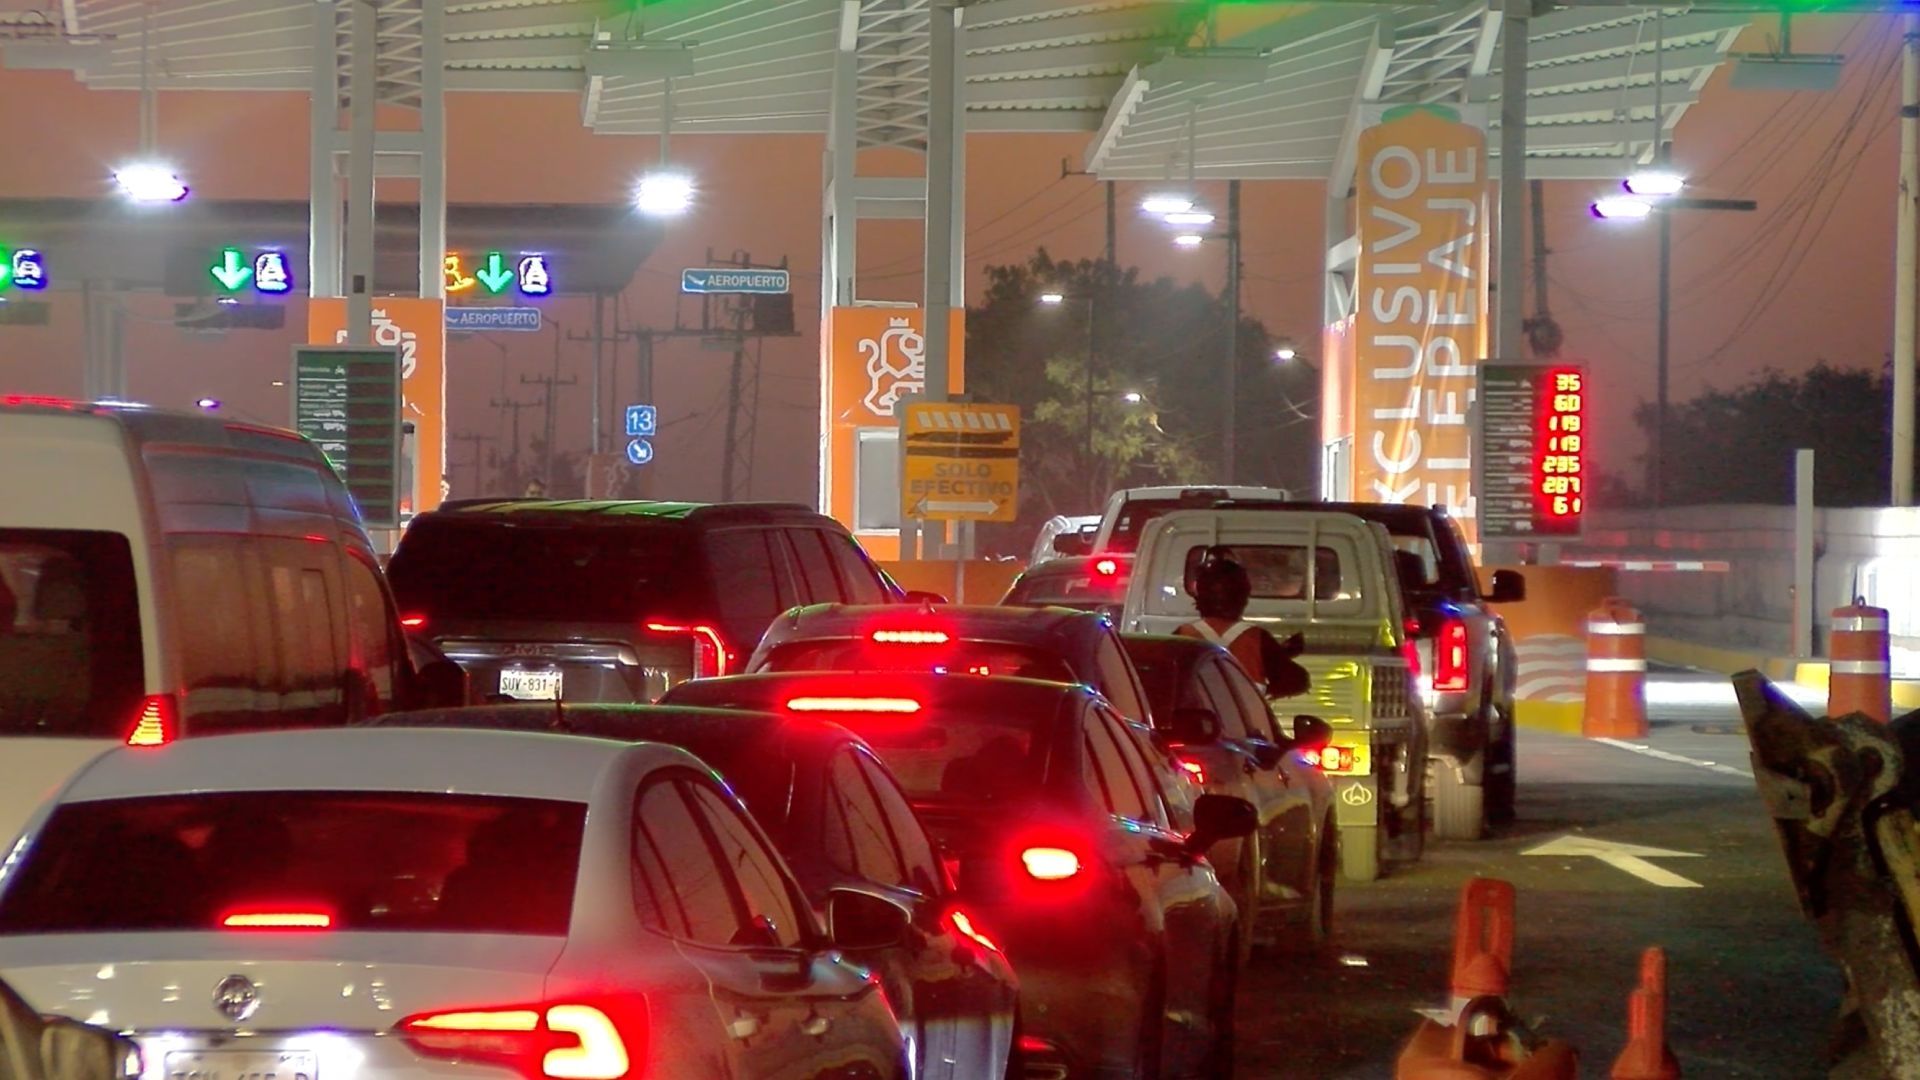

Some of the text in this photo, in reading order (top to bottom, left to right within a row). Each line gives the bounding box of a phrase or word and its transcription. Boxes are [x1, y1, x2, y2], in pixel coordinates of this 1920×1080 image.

[707, 274, 785, 288] AEROPUERTO
[460, 312, 537, 325] AEROPUERTO
[1371, 145, 1421, 504] XCLUSIVO
[1426, 146, 1477, 518] ELEPEAJE
[1556, 373, 1580, 391] 35
[1554, 394, 1580, 412] 60
[630, 411, 652, 430] 13
[1549, 415, 1580, 432] 119
[1549, 435, 1580, 452] 119
[935, 462, 992, 478] SOLO
[911, 479, 1013, 496] EFECTIVO
[1542, 476, 1580, 494] 287
[1553, 496, 1581, 514] 61
